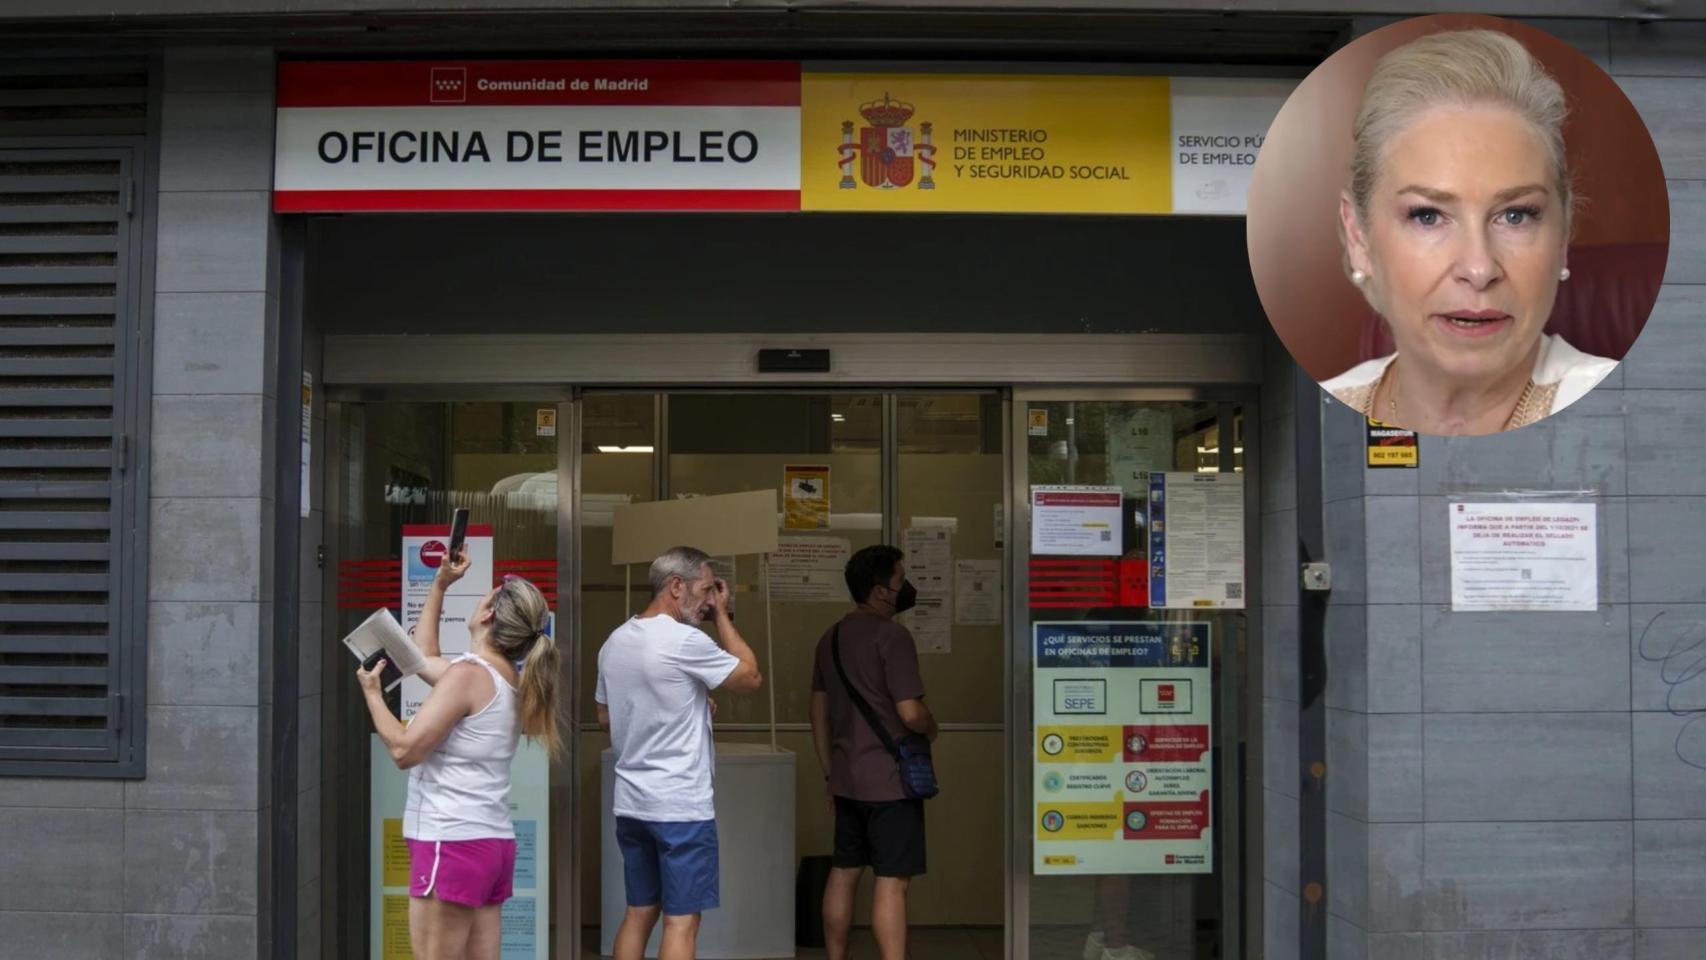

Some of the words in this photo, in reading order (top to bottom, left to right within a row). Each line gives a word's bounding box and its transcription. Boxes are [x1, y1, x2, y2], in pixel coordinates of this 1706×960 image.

[477, 78, 566, 91] Comunidad
[569, 78, 590, 91] de
[594, 78, 649, 91] Madrid
[954, 129, 1048, 143] MINISTERIO
[1178, 135, 1240, 148] SERVICIO
[1244, 134, 1267, 148] PÚ
[317, 130, 491, 163] OFICINA
[506, 130, 563, 163] DE
[578, 130, 759, 163] EMPLEO
[954, 146, 976, 160] DE
[981, 147, 1045, 161] EMPLEO
[1179, 152, 1199, 165] DE
[1202, 153, 1257, 165] EMPLEO
[954, 164, 965, 178] Y
[970, 164, 1065, 179] SEGURIDAD
[1069, 166, 1131, 180] SOCIAL
[1043, 633, 1066, 646] ¿QUÉ
[1067, 635, 1111, 644] SERVICIOS
[1113, 635, 1123, 643] SE
[1124, 635, 1162, 643] PRESTAN
[1044, 648, 1057, 656] EN
[1058, 647, 1098, 656] OFICINAS
[1099, 647, 1110, 656] DE
[1111, 648, 1149, 656] EMPLEO?
[1064, 697, 1096, 710] SEPE
